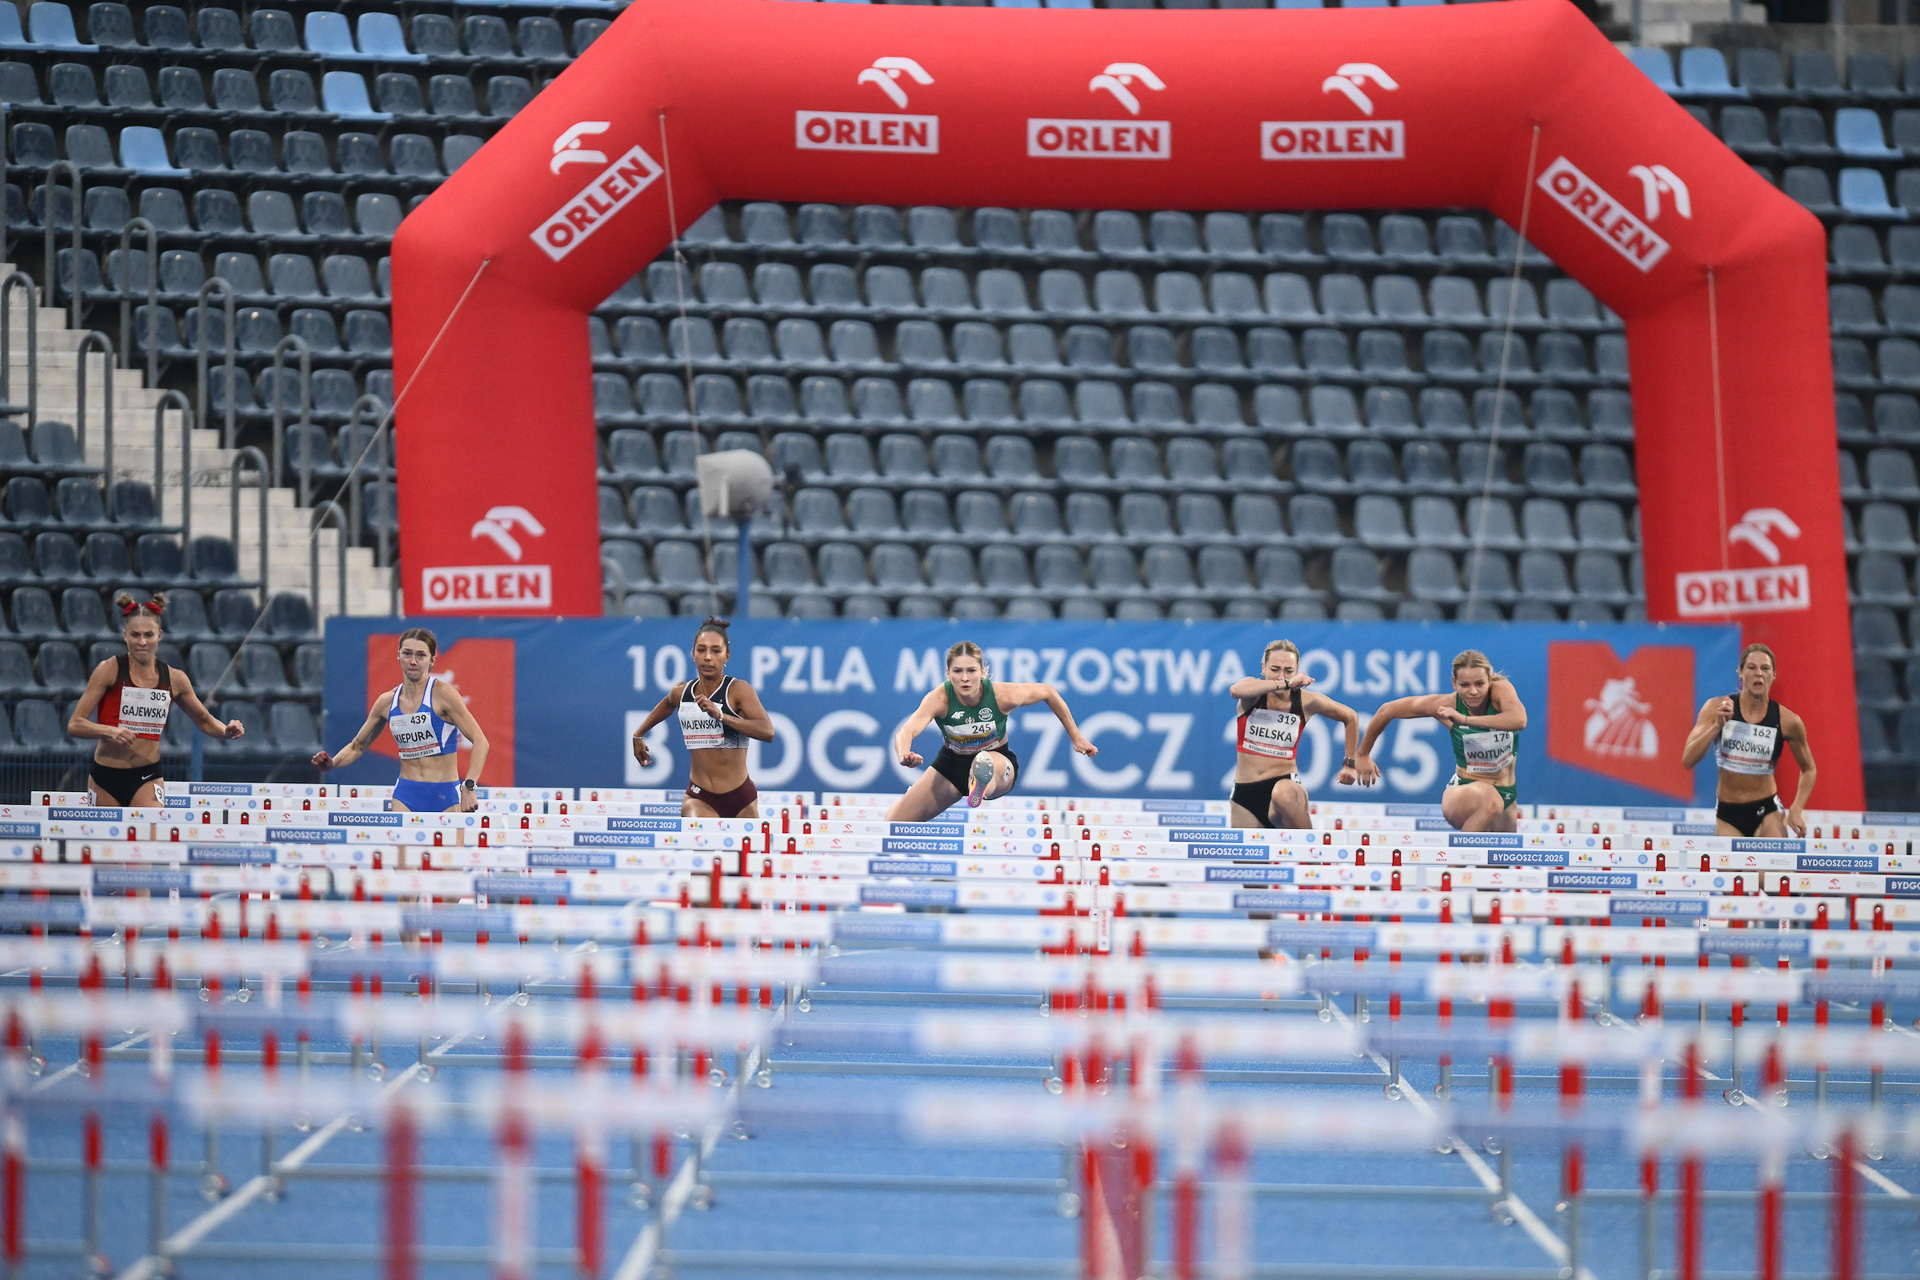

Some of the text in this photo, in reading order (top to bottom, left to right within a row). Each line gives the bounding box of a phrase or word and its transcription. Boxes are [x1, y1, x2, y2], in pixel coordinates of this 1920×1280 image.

[804, 117, 929, 148] ORLEN
[1036, 124, 1161, 154] ORLEN
[1269, 127, 1395, 154] ORLEN
[545, 155, 653, 249] ORLEN
[1549, 168, 1657, 267] ORLEN
[429, 572, 541, 601] ORLEN
[1685, 574, 1800, 606] ORLEN
[752, 645, 876, 692] PZLA
[1297, 649, 1440, 695] OLSKI
[150, 691, 167, 702] 305
[121, 705, 167, 719] GAJEWSKA
[410, 714, 427, 725] 439
[680, 719, 721, 730] MAJEWSKA
[1277, 713, 1297, 726] 319
[971, 723, 992, 735] 245
[1249, 725, 1292, 743] SIELSKA
[1752, 727, 1772, 739] 162
[393, 729, 434, 744] KIEPURA
[1722, 737, 1771, 756] WESOŁOWSKA
[53, 810, 118, 818] BYDGOSZCZ 2025
[644, 806, 682, 814] BYDGOSZC
[334, 815, 398, 824] BYDGOSZCZ 2025
[612, 820, 676, 829] BYDGOSZCZ 2025
[1162, 816, 1204, 824] BYDGOSZCZ
[16, 825, 35, 833] 2025
[894, 826, 960, 834] BYDGOSZCZ 2025
[270, 830, 342, 840] BYDGOSZCZ 2025
[578, 834, 650, 844] BYDGOSZCZ 2025
[1174, 832, 1238, 840] BYDGOSZCZ 2025
[1453, 836, 1518, 845] BYDGOSZCZ 2025
[887, 841, 958, 850] BYDGOSZCZ 2025
[1736, 841, 1801, 850] BYDGOSZCZ 2025
[1193, 848, 1264, 857] BYDGOSZCZ 2025
[1493, 854, 1564, 863] BYDGOSZCZ 2025
[1802, 858, 1873, 868] BYDGOSZCZ 2025
[1210, 868, 1289, 880] BYDGOSZCZ 2025
[1552, 875, 1632, 886] BYDGOSZCZ 2025
